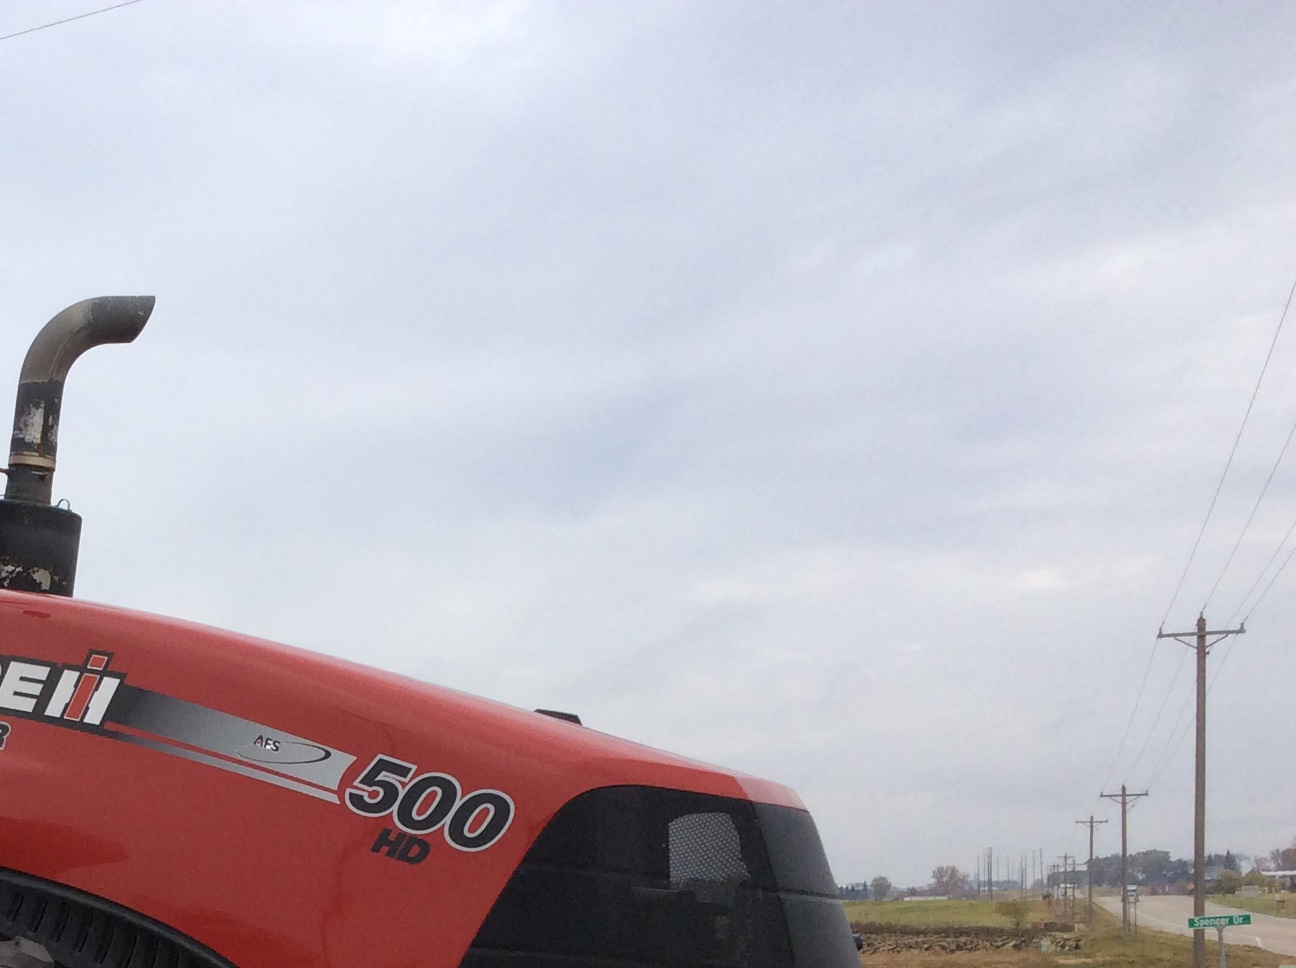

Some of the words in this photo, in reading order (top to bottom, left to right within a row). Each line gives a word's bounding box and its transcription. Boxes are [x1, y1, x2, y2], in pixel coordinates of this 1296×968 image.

[253, 734, 281, 753] AFS
[344, 753, 515, 852] 500
[370, 827, 431, 865] HD
[1194, 917, 1230, 927] Spencer
[1233, 915, 1244, 925] Dr
